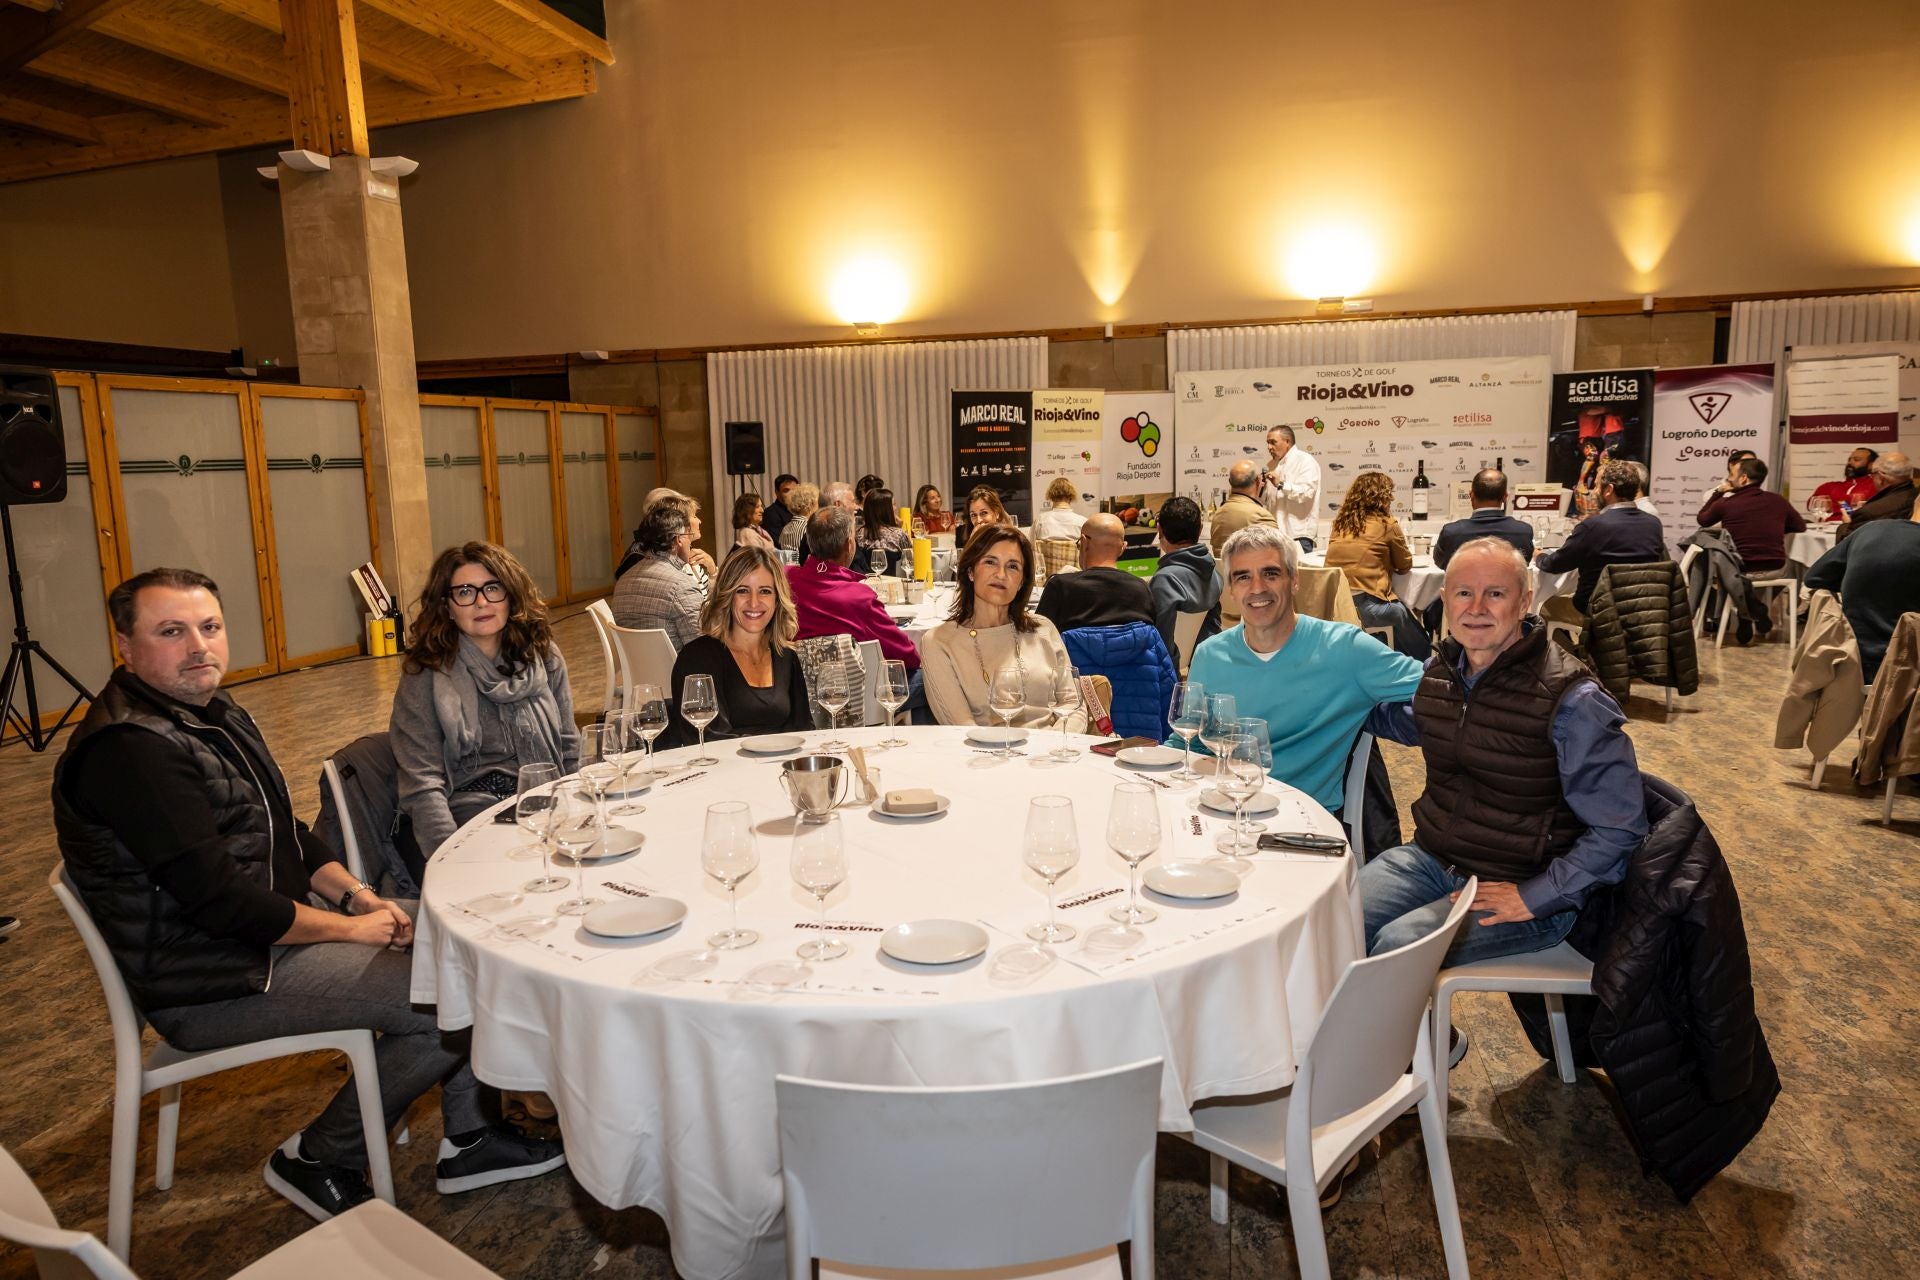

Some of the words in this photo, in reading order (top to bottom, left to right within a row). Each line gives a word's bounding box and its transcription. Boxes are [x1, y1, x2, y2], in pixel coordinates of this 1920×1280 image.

[1316, 370, 1351, 378] TORNEOS
[1430, 376, 1447, 384] MARCO
[1297, 381, 1414, 402] Rioja&Vino
[1568, 394, 1602, 403] etiquetas
[1603, 393, 1638, 402] adhesivas
[960, 405, 997, 426] MARCO
[999, 404, 1027, 425] REAL
[1034, 408, 1100, 423] Rioja&Vino
[1237, 424, 1245, 432] La
[1247, 423, 1268, 432] Rioja
[1339, 418, 1380, 427] LOGROÑO
[1662, 429, 1707, 441] Logroño
[1711, 428, 1758, 439] Deporte
[1128, 461, 1160, 471] Fundación
[1117, 472, 1133, 481] Rioja
[1134, 470, 1161, 480] Deporte
